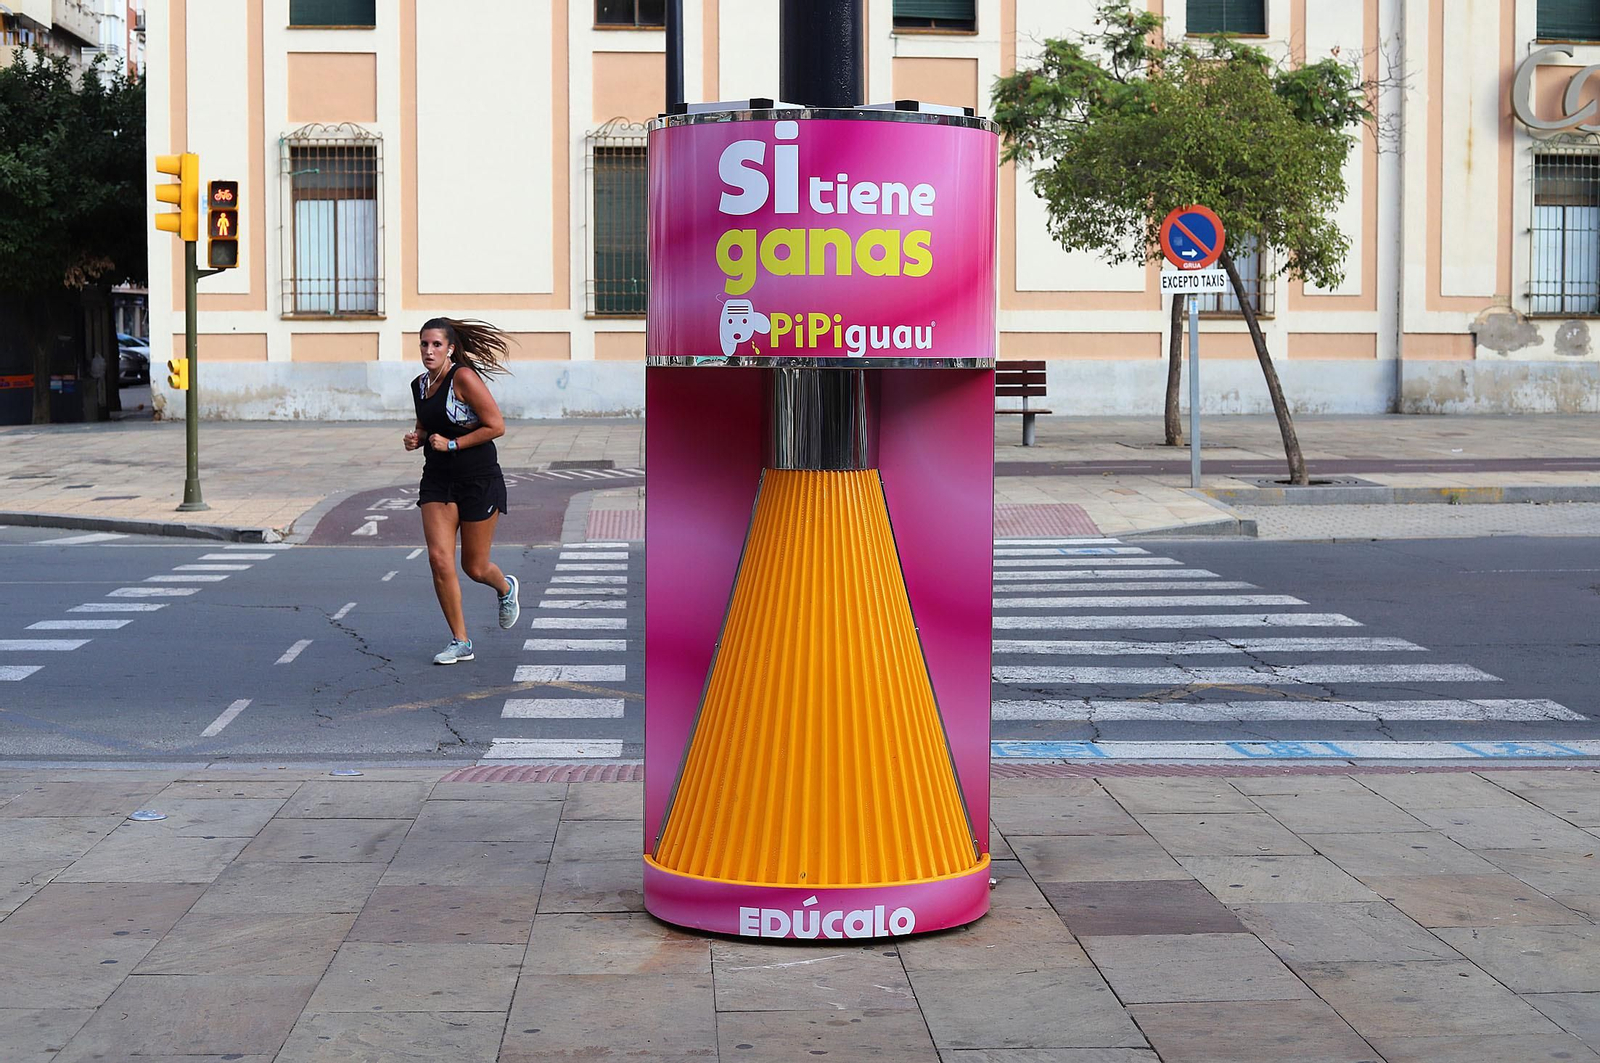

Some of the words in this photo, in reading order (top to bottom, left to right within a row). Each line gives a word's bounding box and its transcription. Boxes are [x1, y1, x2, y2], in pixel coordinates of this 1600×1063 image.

[809, 173, 936, 216] tiene
[715, 227, 933, 296] ganas
[1162, 275, 1199, 289] EXCEPTO
[1201, 274, 1225, 287] TAXIS
